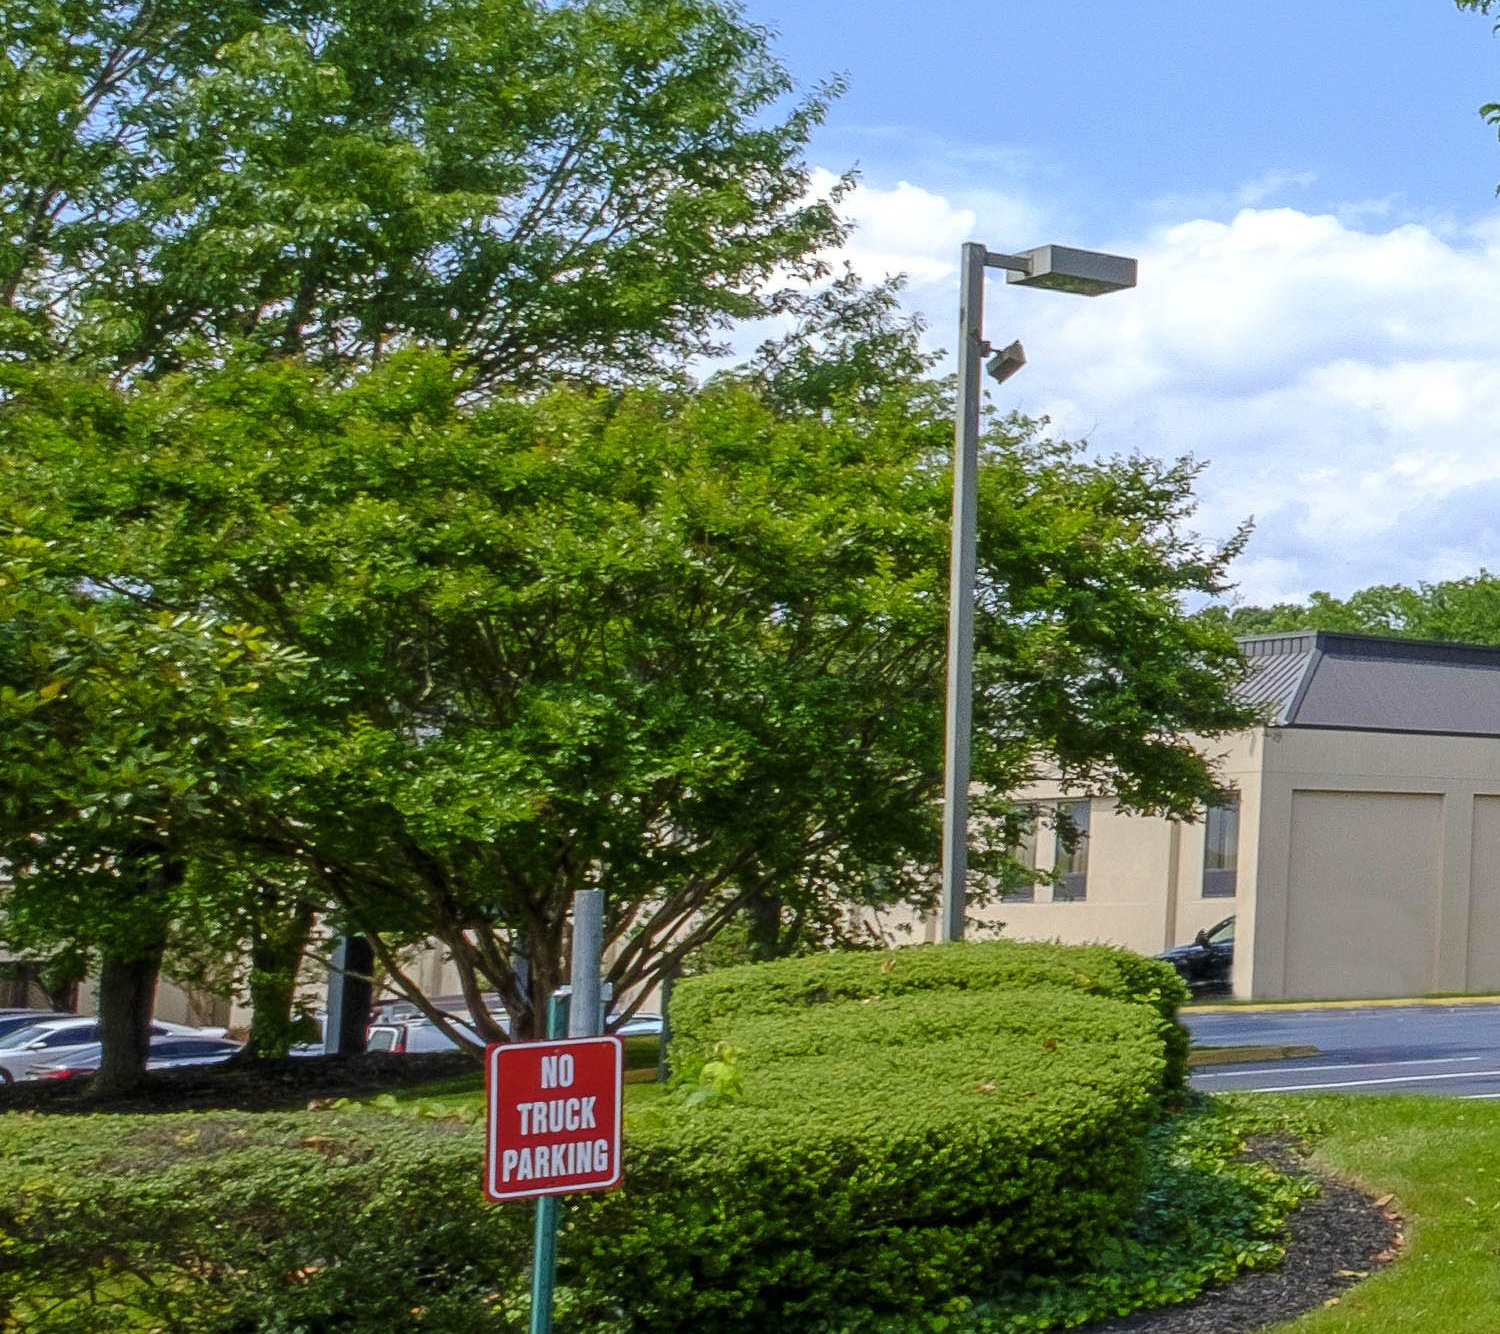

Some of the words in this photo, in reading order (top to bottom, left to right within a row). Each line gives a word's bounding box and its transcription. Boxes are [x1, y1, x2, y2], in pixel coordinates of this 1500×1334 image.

[541, 1053, 575, 1089] NO
[516, 1096, 597, 1136] TRUCK
[502, 1138, 608, 1183] PARKING
